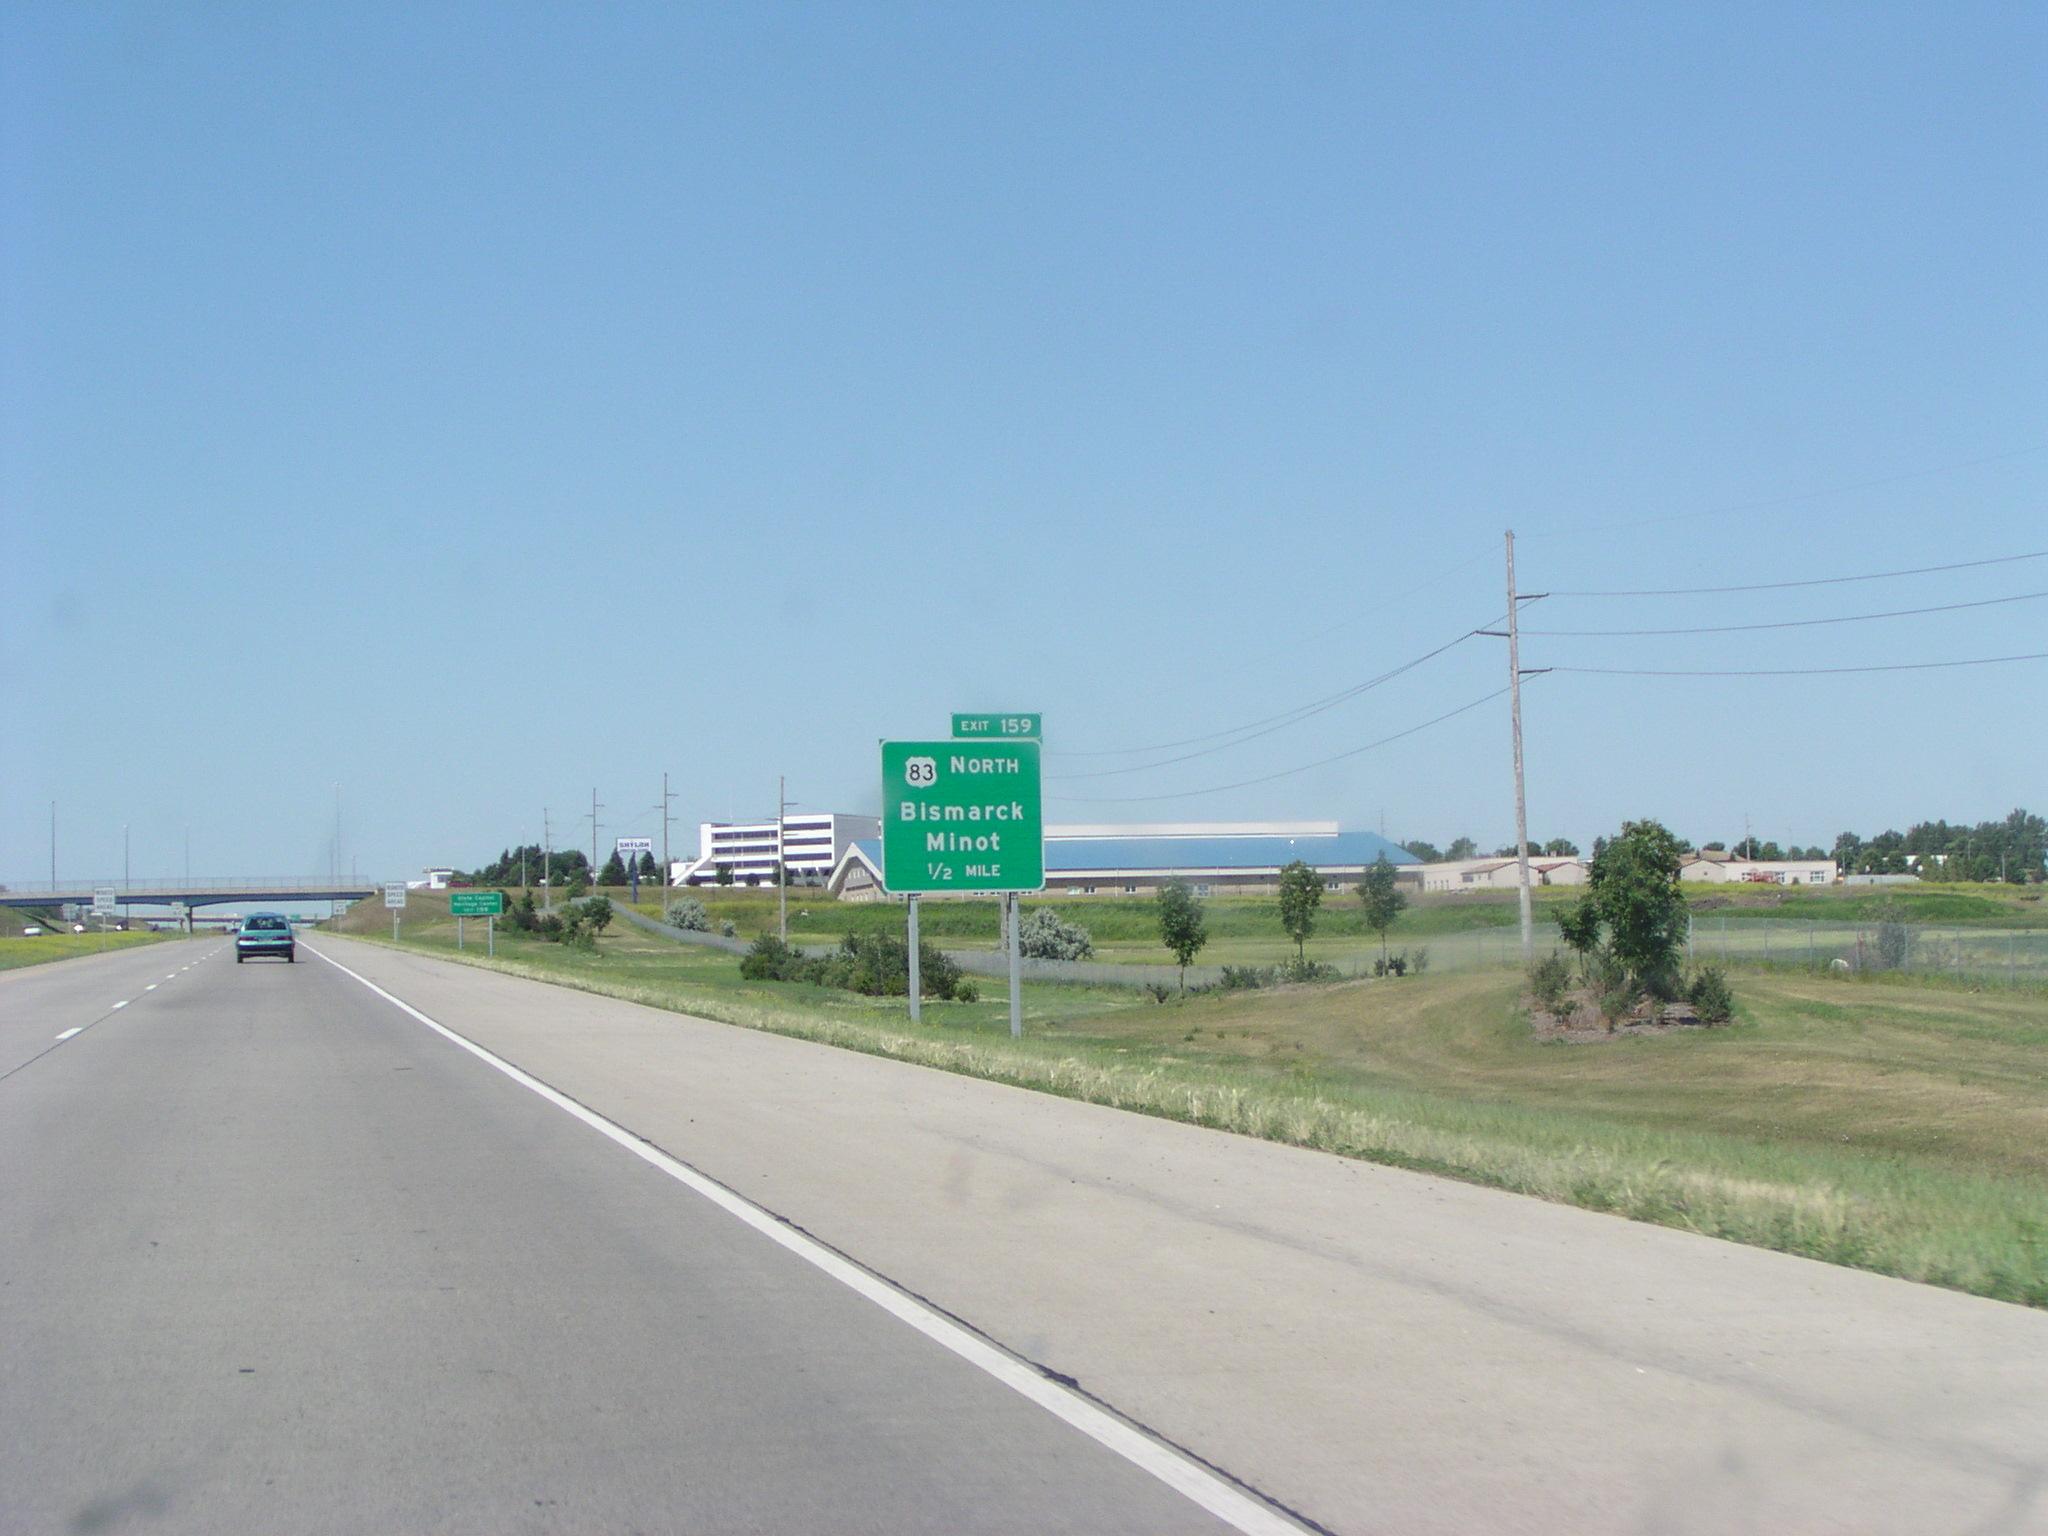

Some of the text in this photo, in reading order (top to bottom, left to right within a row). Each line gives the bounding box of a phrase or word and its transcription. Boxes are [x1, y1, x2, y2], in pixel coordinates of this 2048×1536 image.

[961, 719, 1031, 733] EXIT 159
[909, 756, 1019, 781] 83 NORTH
[900, 801, 1024, 821] Bismarck
[926, 832, 1000, 851] Minot
[965, 864, 1001, 877] MILE
